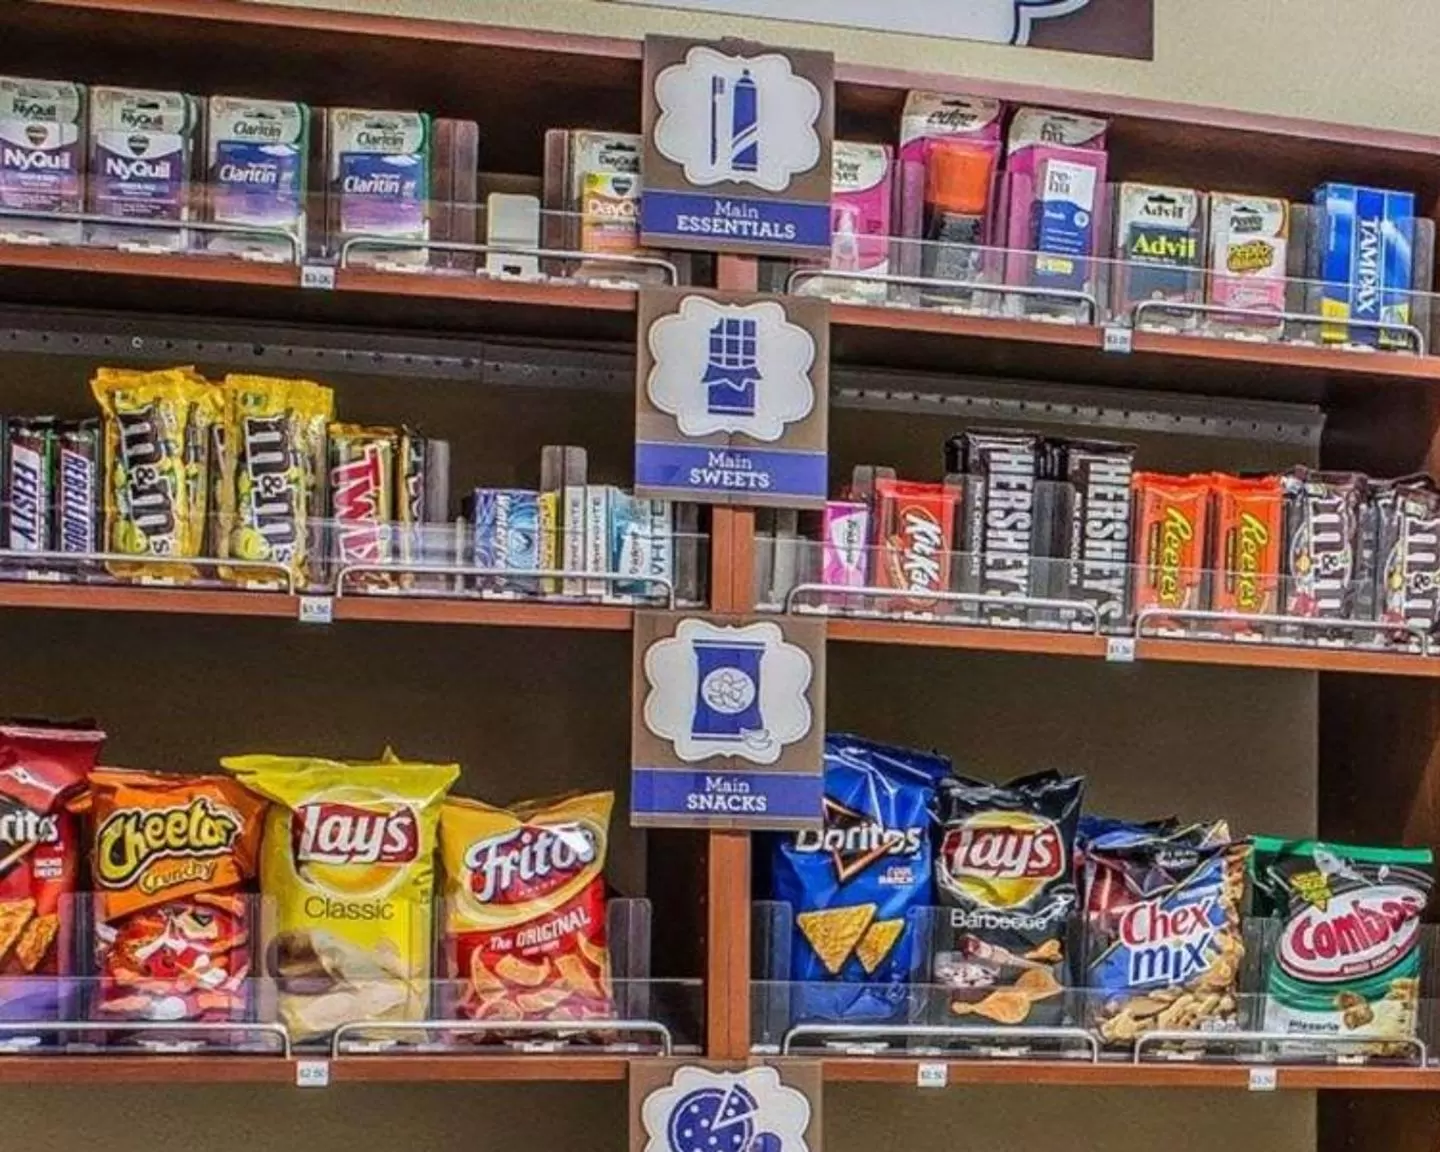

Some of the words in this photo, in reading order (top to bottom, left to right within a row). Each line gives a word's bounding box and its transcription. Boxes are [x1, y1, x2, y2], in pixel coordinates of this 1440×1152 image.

[4, 148, 71, 170] NyQuil
[106, 157, 170, 180] NyQuil
[219, 163, 277, 184] Claritin
[343, 175, 401, 194] Claritin
[714, 200, 759, 219] Main
[1138, 202, 1184, 219] Advil
[677, 215, 797, 240] ESSENTIALS
[1132, 234, 1196, 260] Advil
[1357, 215, 1379, 314] TAMPAX
[709, 451, 753, 470] Main
[689, 467, 771, 489] SWEETS
[13, 461, 38, 543] FEISTY
[705, 777, 750, 794] Main
[687, 793, 768, 813] SNACKS
[100, 799, 238, 885] Cheetos
[299, 804, 413, 862] Lay's
[796, 822, 922, 853] Doritos
[949, 826, 1055, 877] Lay's
[465, 827, 595, 902] Fritos
[304, 897, 396, 921] Classic
[950, 907, 1048, 931] Barbecue
[489, 936, 513, 951] The
[516, 906, 592, 948] ORIGINAL
[1121, 899, 1213, 946] Chex
[1291, 896, 1419, 961] Combos
[1131, 933, 1211, 983] mix
